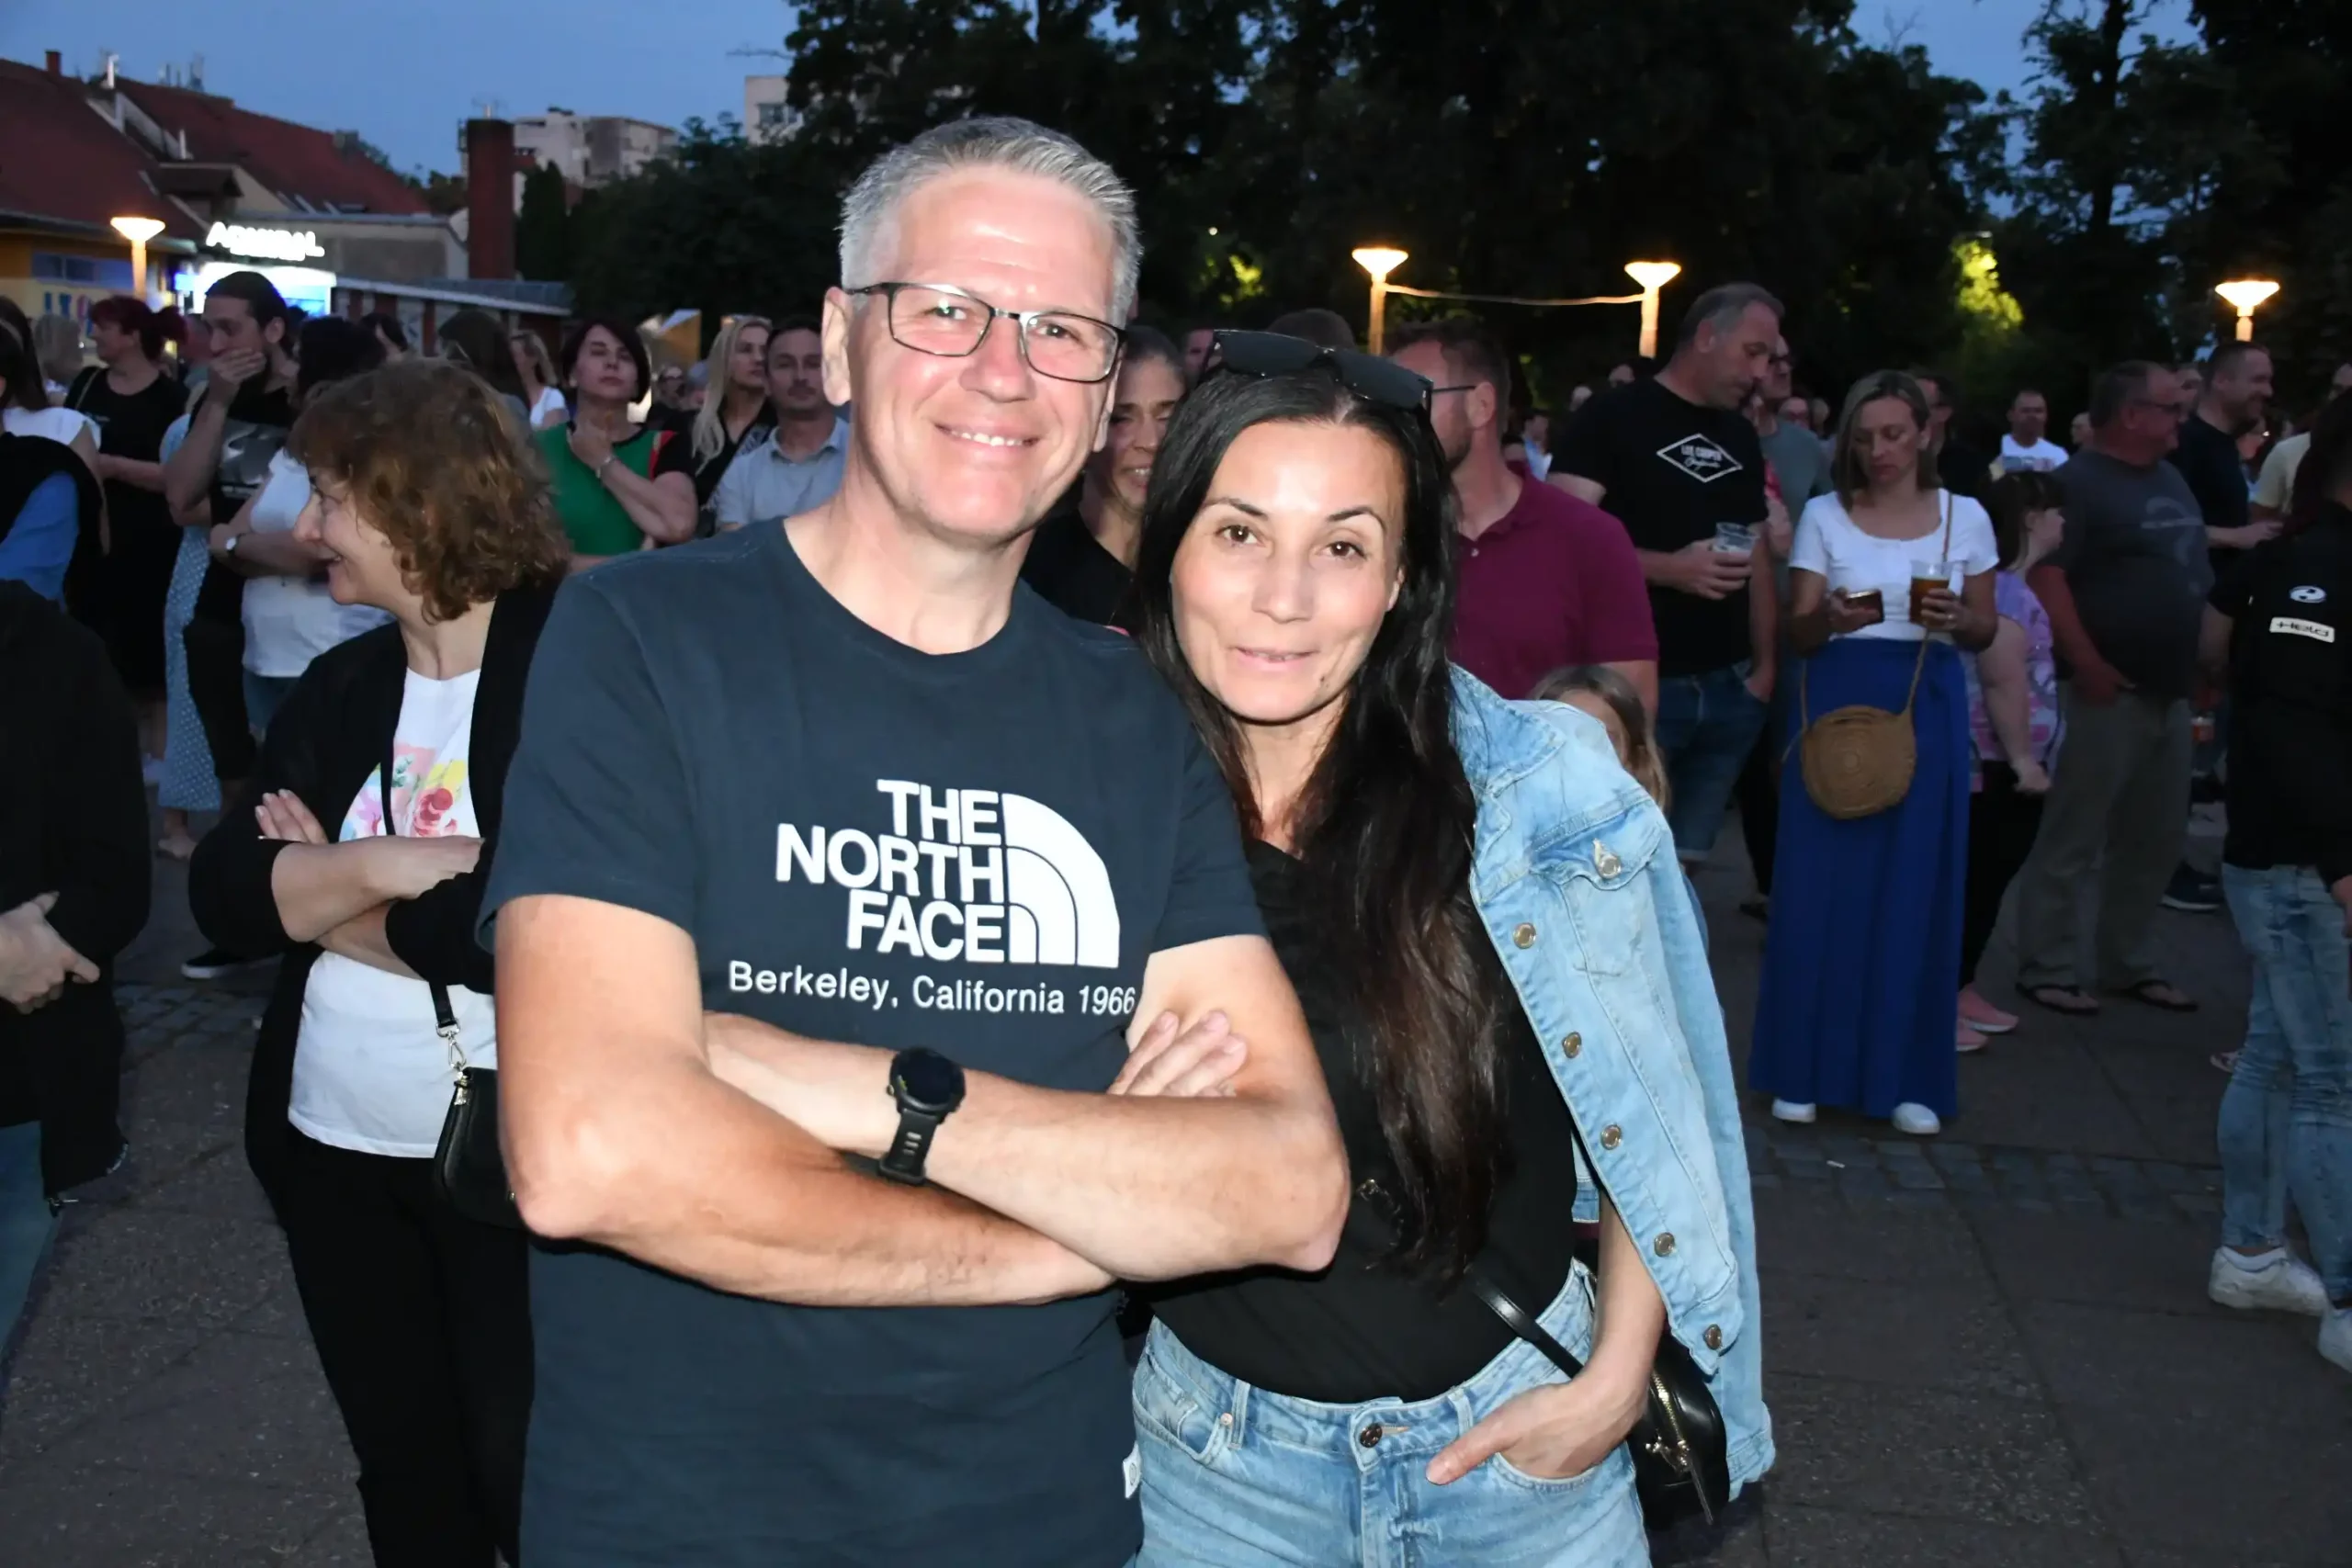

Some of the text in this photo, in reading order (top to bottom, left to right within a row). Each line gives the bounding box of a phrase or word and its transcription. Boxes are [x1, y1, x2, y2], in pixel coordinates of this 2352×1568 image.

[876, 779, 1002, 846] THE
[775, 822, 1005, 903] NORTH
[847, 888, 1005, 963] FACE
[729, 960, 1136, 1016] Berkeley, California 1966
